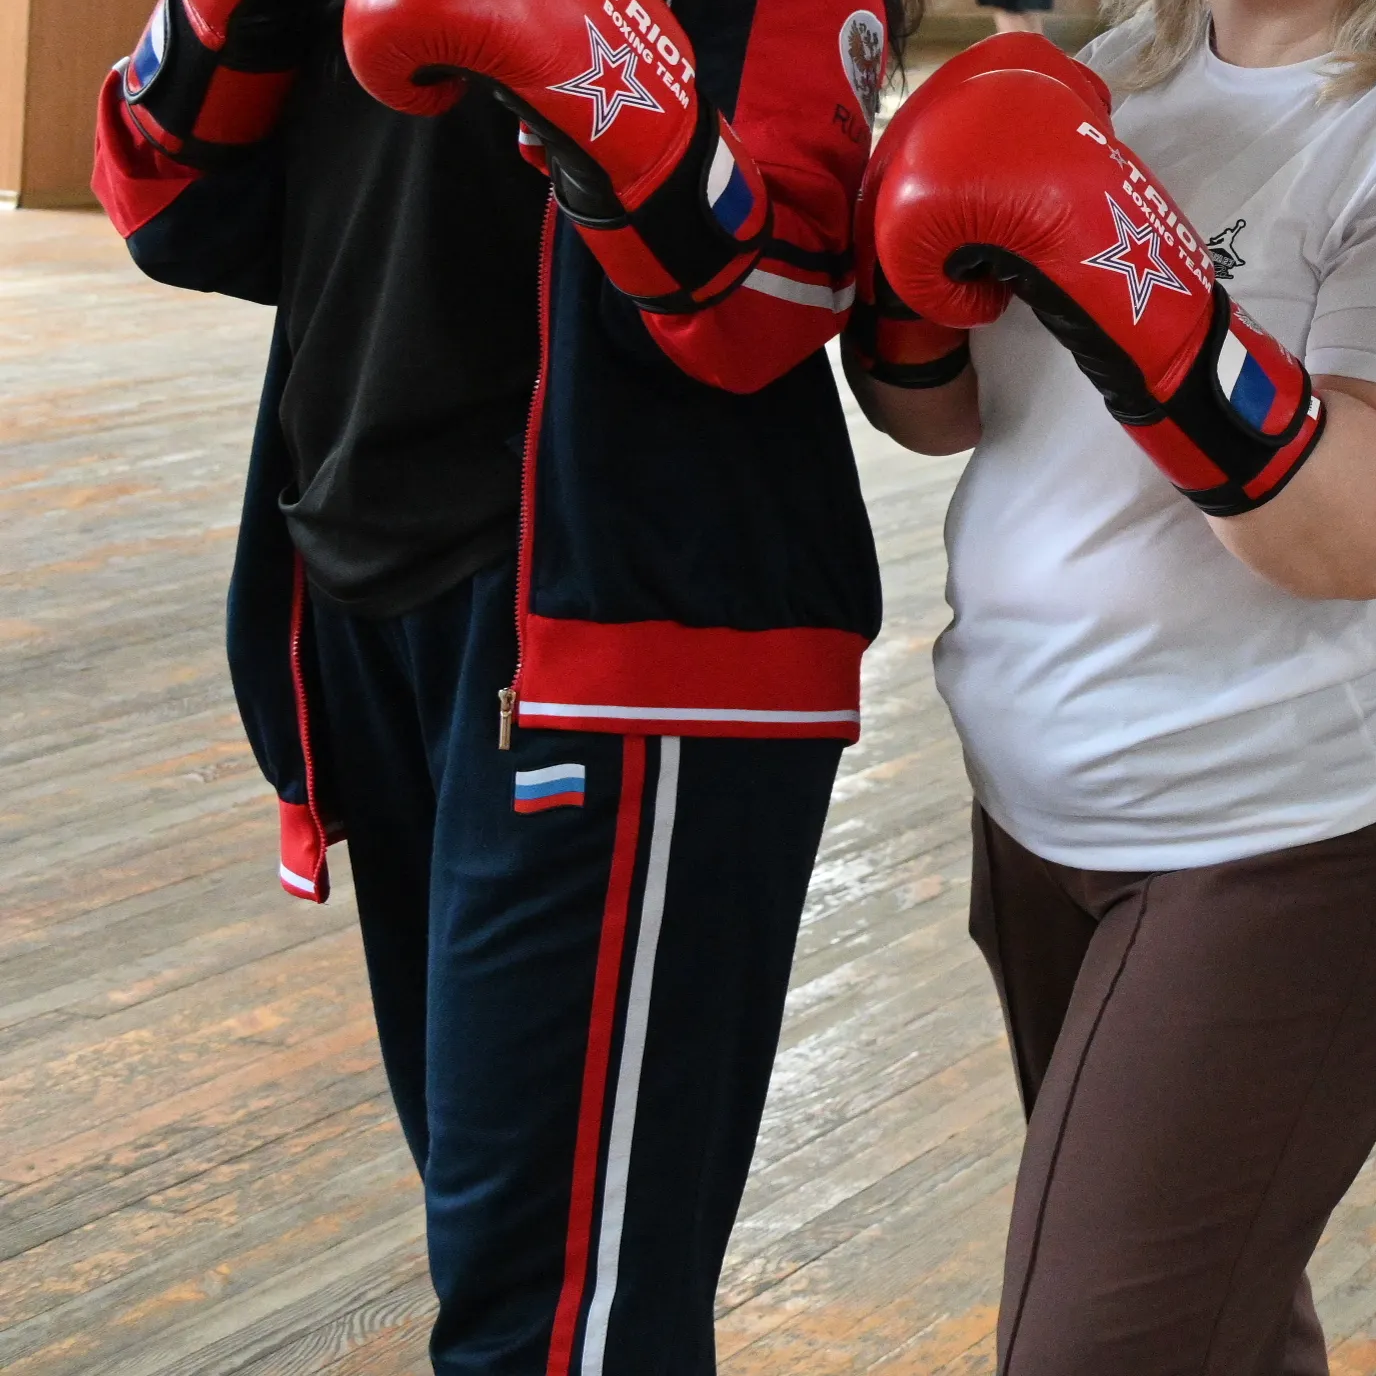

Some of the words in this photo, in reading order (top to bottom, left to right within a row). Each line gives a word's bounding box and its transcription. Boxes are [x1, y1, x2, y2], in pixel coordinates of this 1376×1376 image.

[656, 60, 690, 110] TEAM
[1122, 179, 1175, 247] BOXING
[1177, 245, 1213, 294] TEAM
